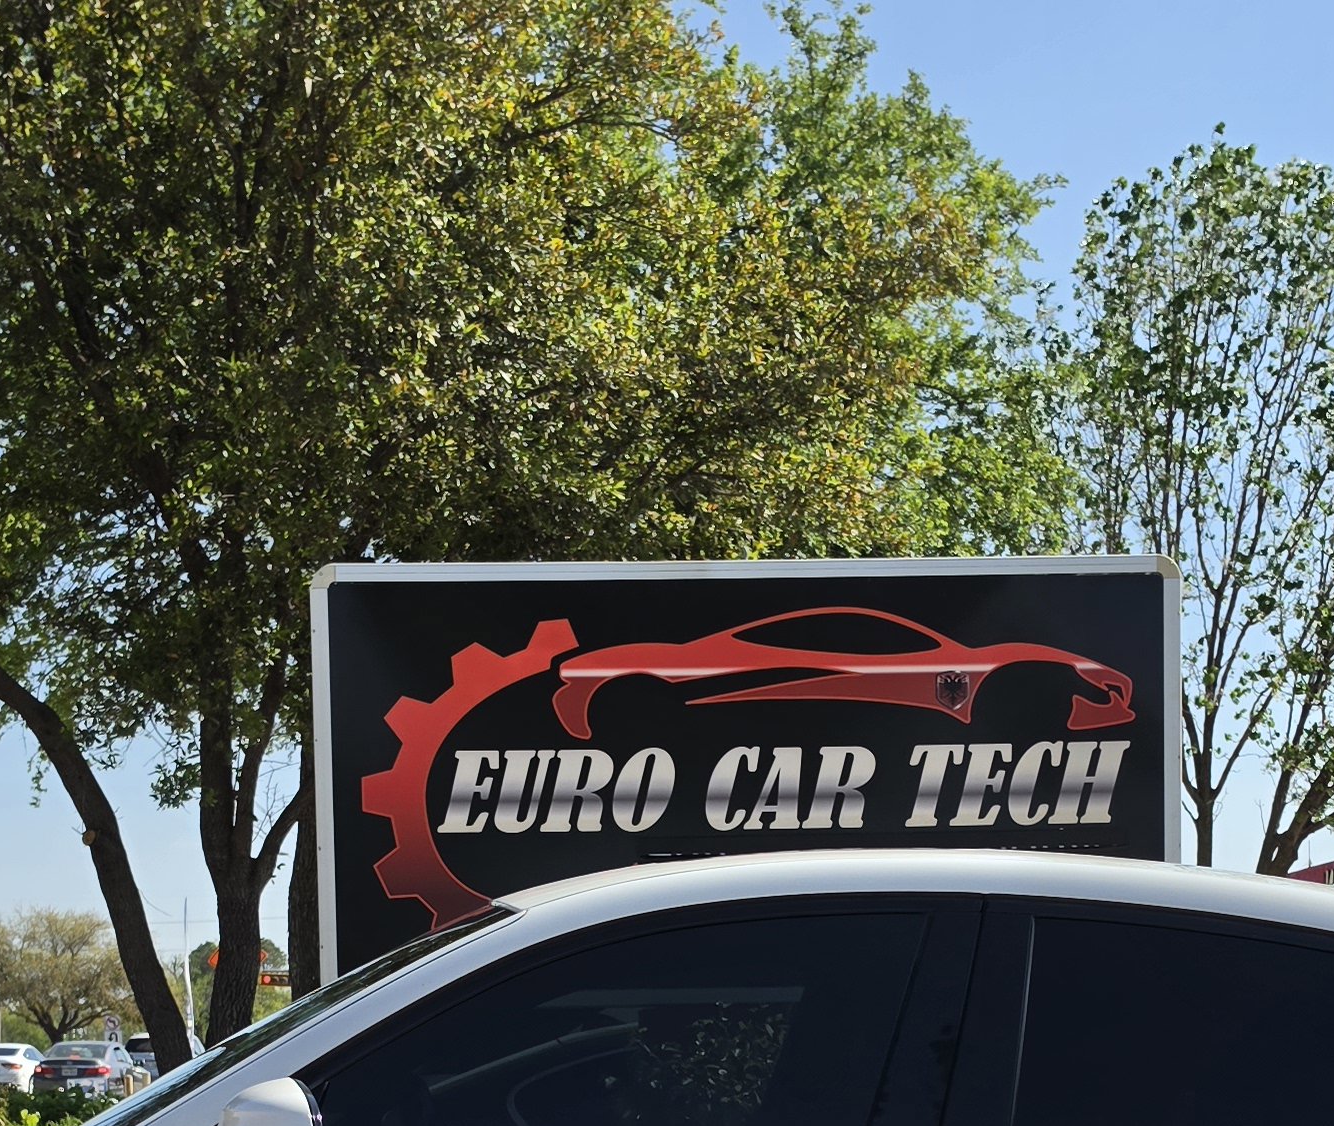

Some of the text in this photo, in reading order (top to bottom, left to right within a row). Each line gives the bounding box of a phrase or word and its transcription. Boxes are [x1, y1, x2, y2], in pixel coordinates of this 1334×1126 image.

[438, 739, 1131, 834] EURO CAR TECH
